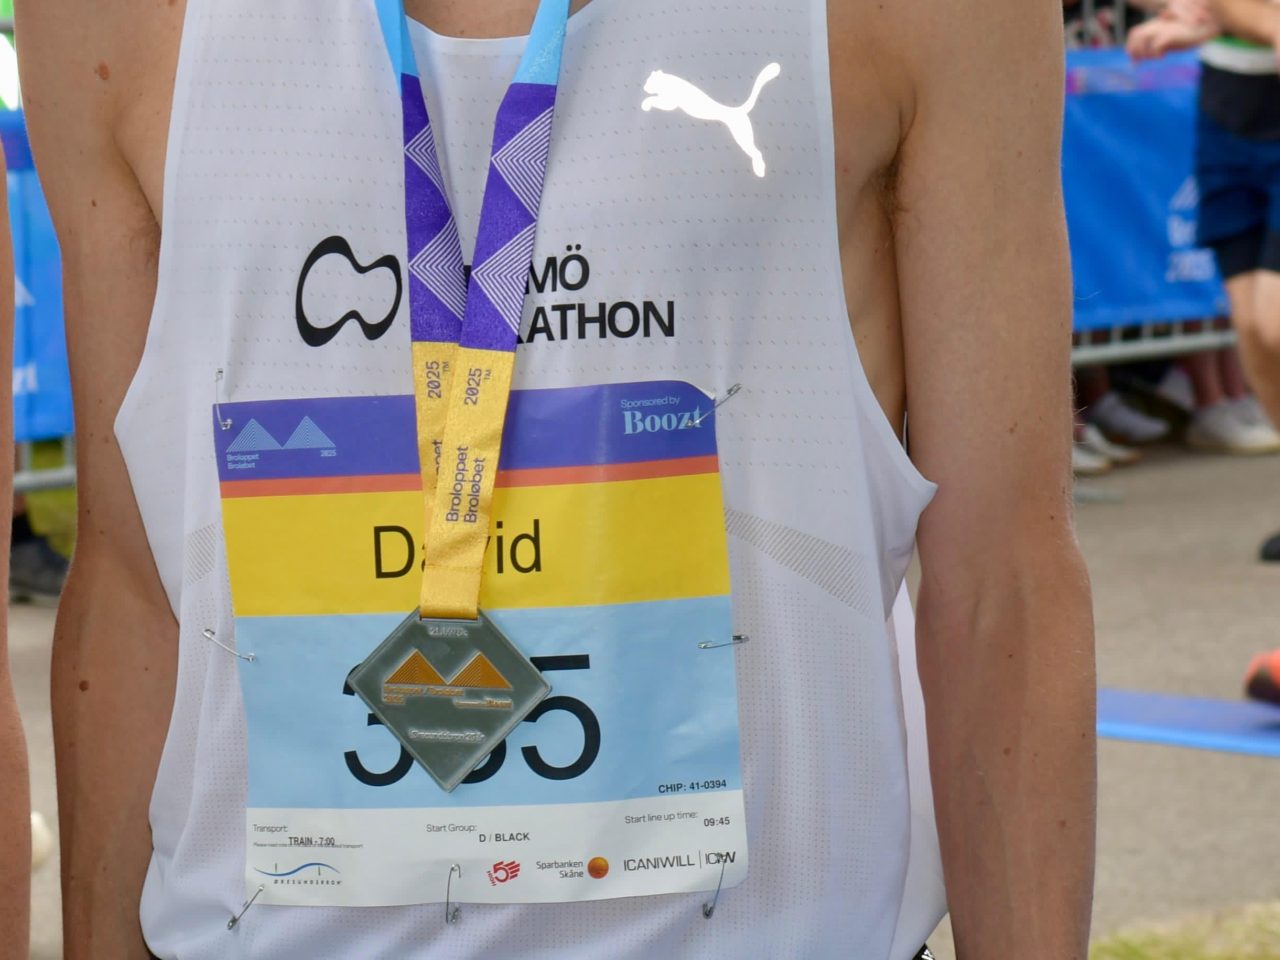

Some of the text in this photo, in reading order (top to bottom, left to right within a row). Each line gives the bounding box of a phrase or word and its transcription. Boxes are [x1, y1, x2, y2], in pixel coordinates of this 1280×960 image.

[519, 301, 674, 344] ATHON
[425, 360, 442, 399] 2025
[464, 367, 483, 406] 2025
[620, 395, 680, 409] Sponsored by
[623, 405, 702, 435] Boozt
[446, 446, 469, 522] Broloppet
[374, 519, 542, 579] Did
[658, 779, 727, 794] CHIP: 41-0394
[624, 815, 647, 824] Start
[647, 813, 662, 822] line
[663, 814, 675, 822] up
[703, 817, 731, 827] 09:45
[426, 823, 477, 833] Start Group:
[288, 837, 313, 846] TRAIN
[319, 837, 336, 846] 7:00
[479, 833, 486, 842] D
[494, 832, 530, 842] BLACK
[536, 861, 584, 870] Sparbanken
[623, 854, 696, 872] ICANIWILL
[559, 869, 584, 879] Skåne
